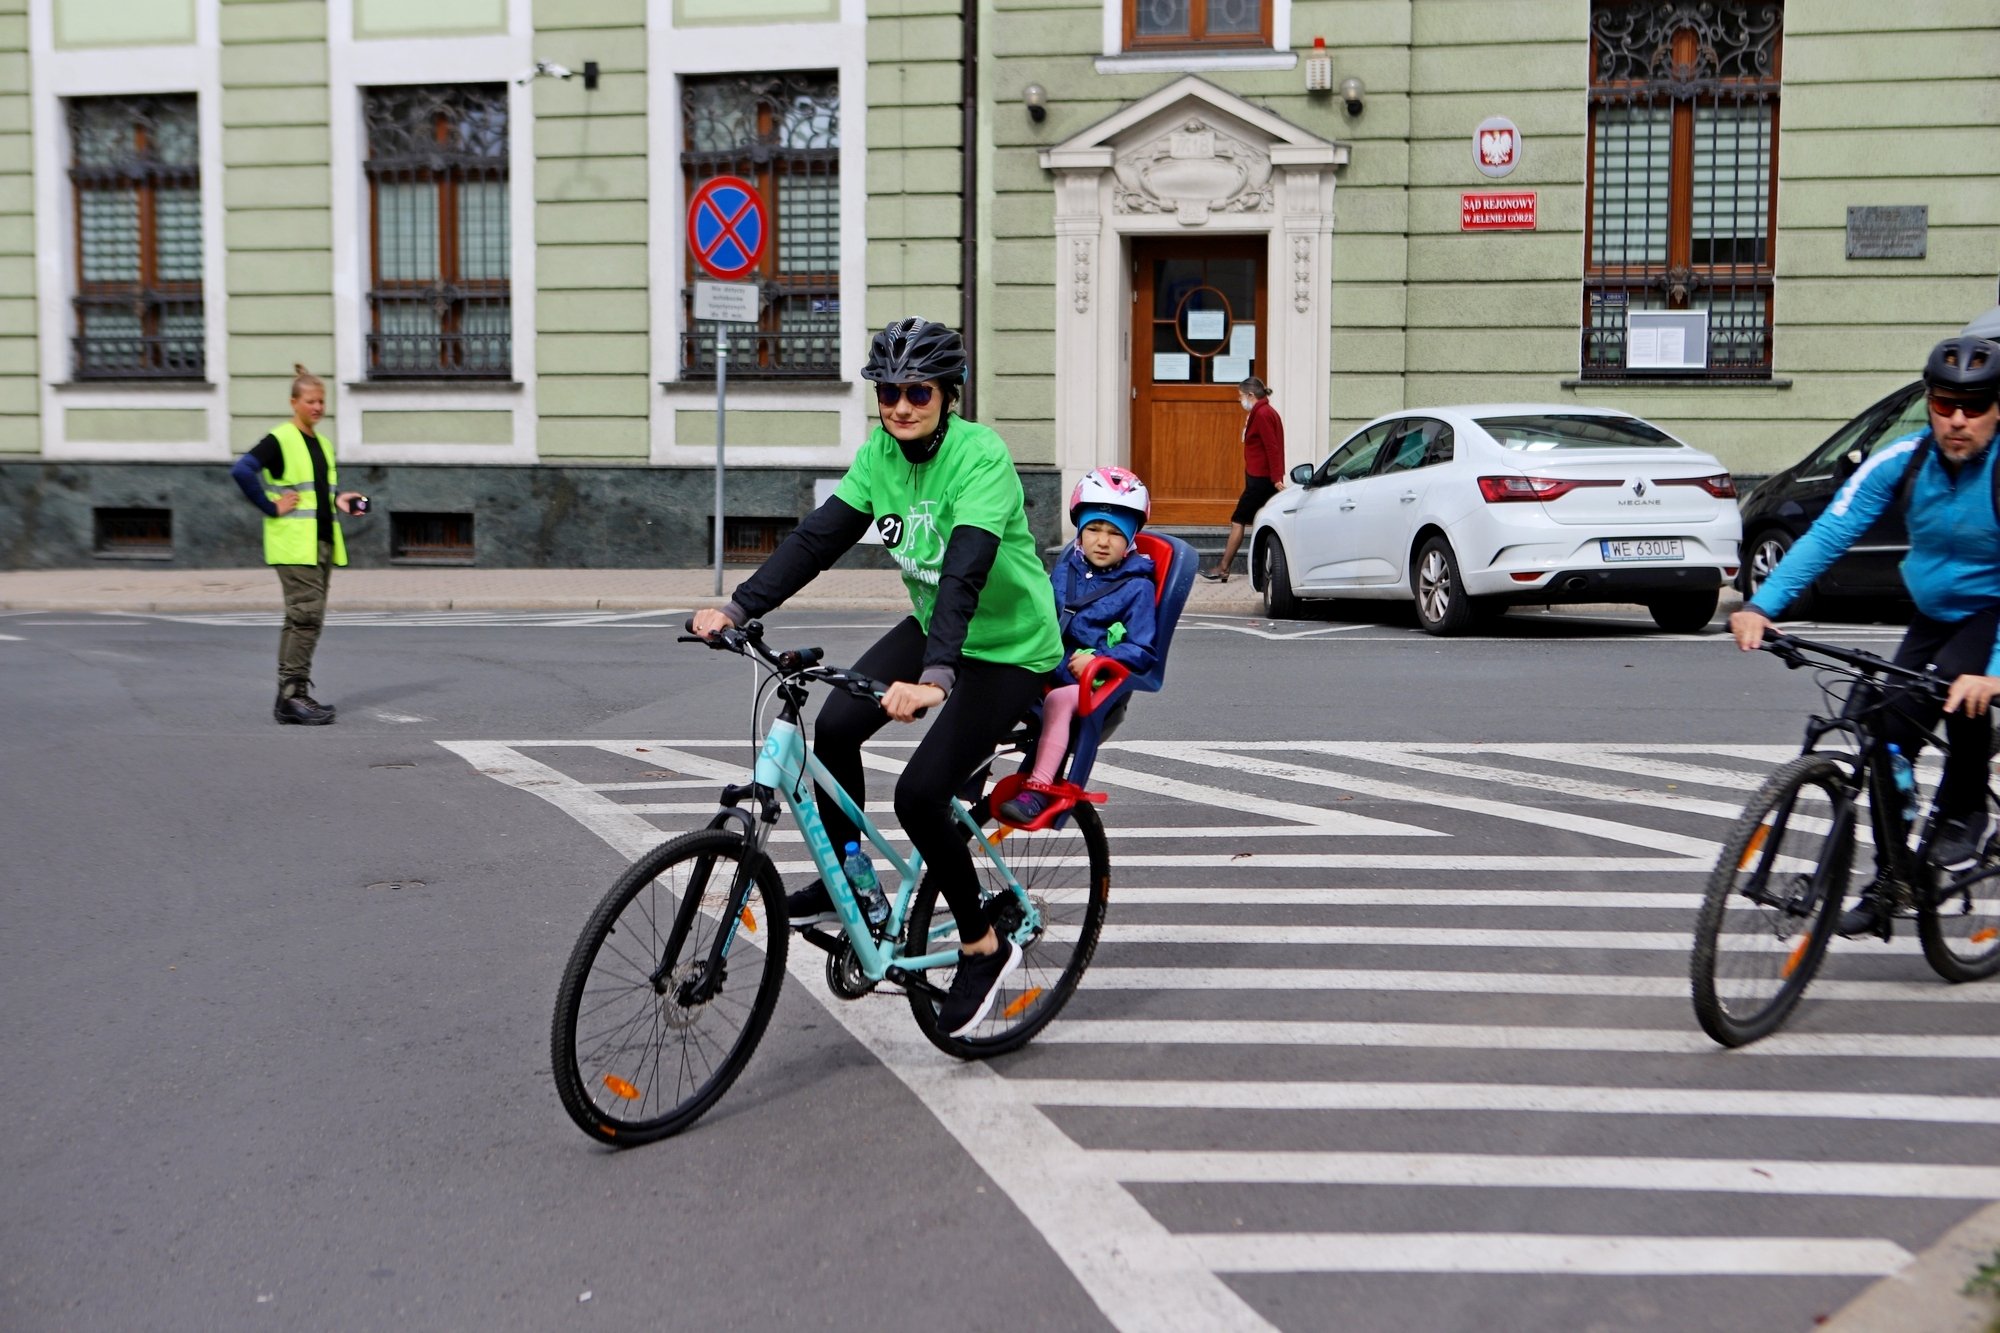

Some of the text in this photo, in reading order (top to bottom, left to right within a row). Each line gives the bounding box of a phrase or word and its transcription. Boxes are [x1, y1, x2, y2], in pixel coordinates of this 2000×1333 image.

[1463, 198, 1534, 212] SĄD REJONOWY
[1464, 212, 1533, 223] W JELENIEJ GÓRZE
[881, 518, 902, 543] 21
[1612, 541, 1678, 556] WE 630UF
[799, 801, 858, 924] KELLYS
